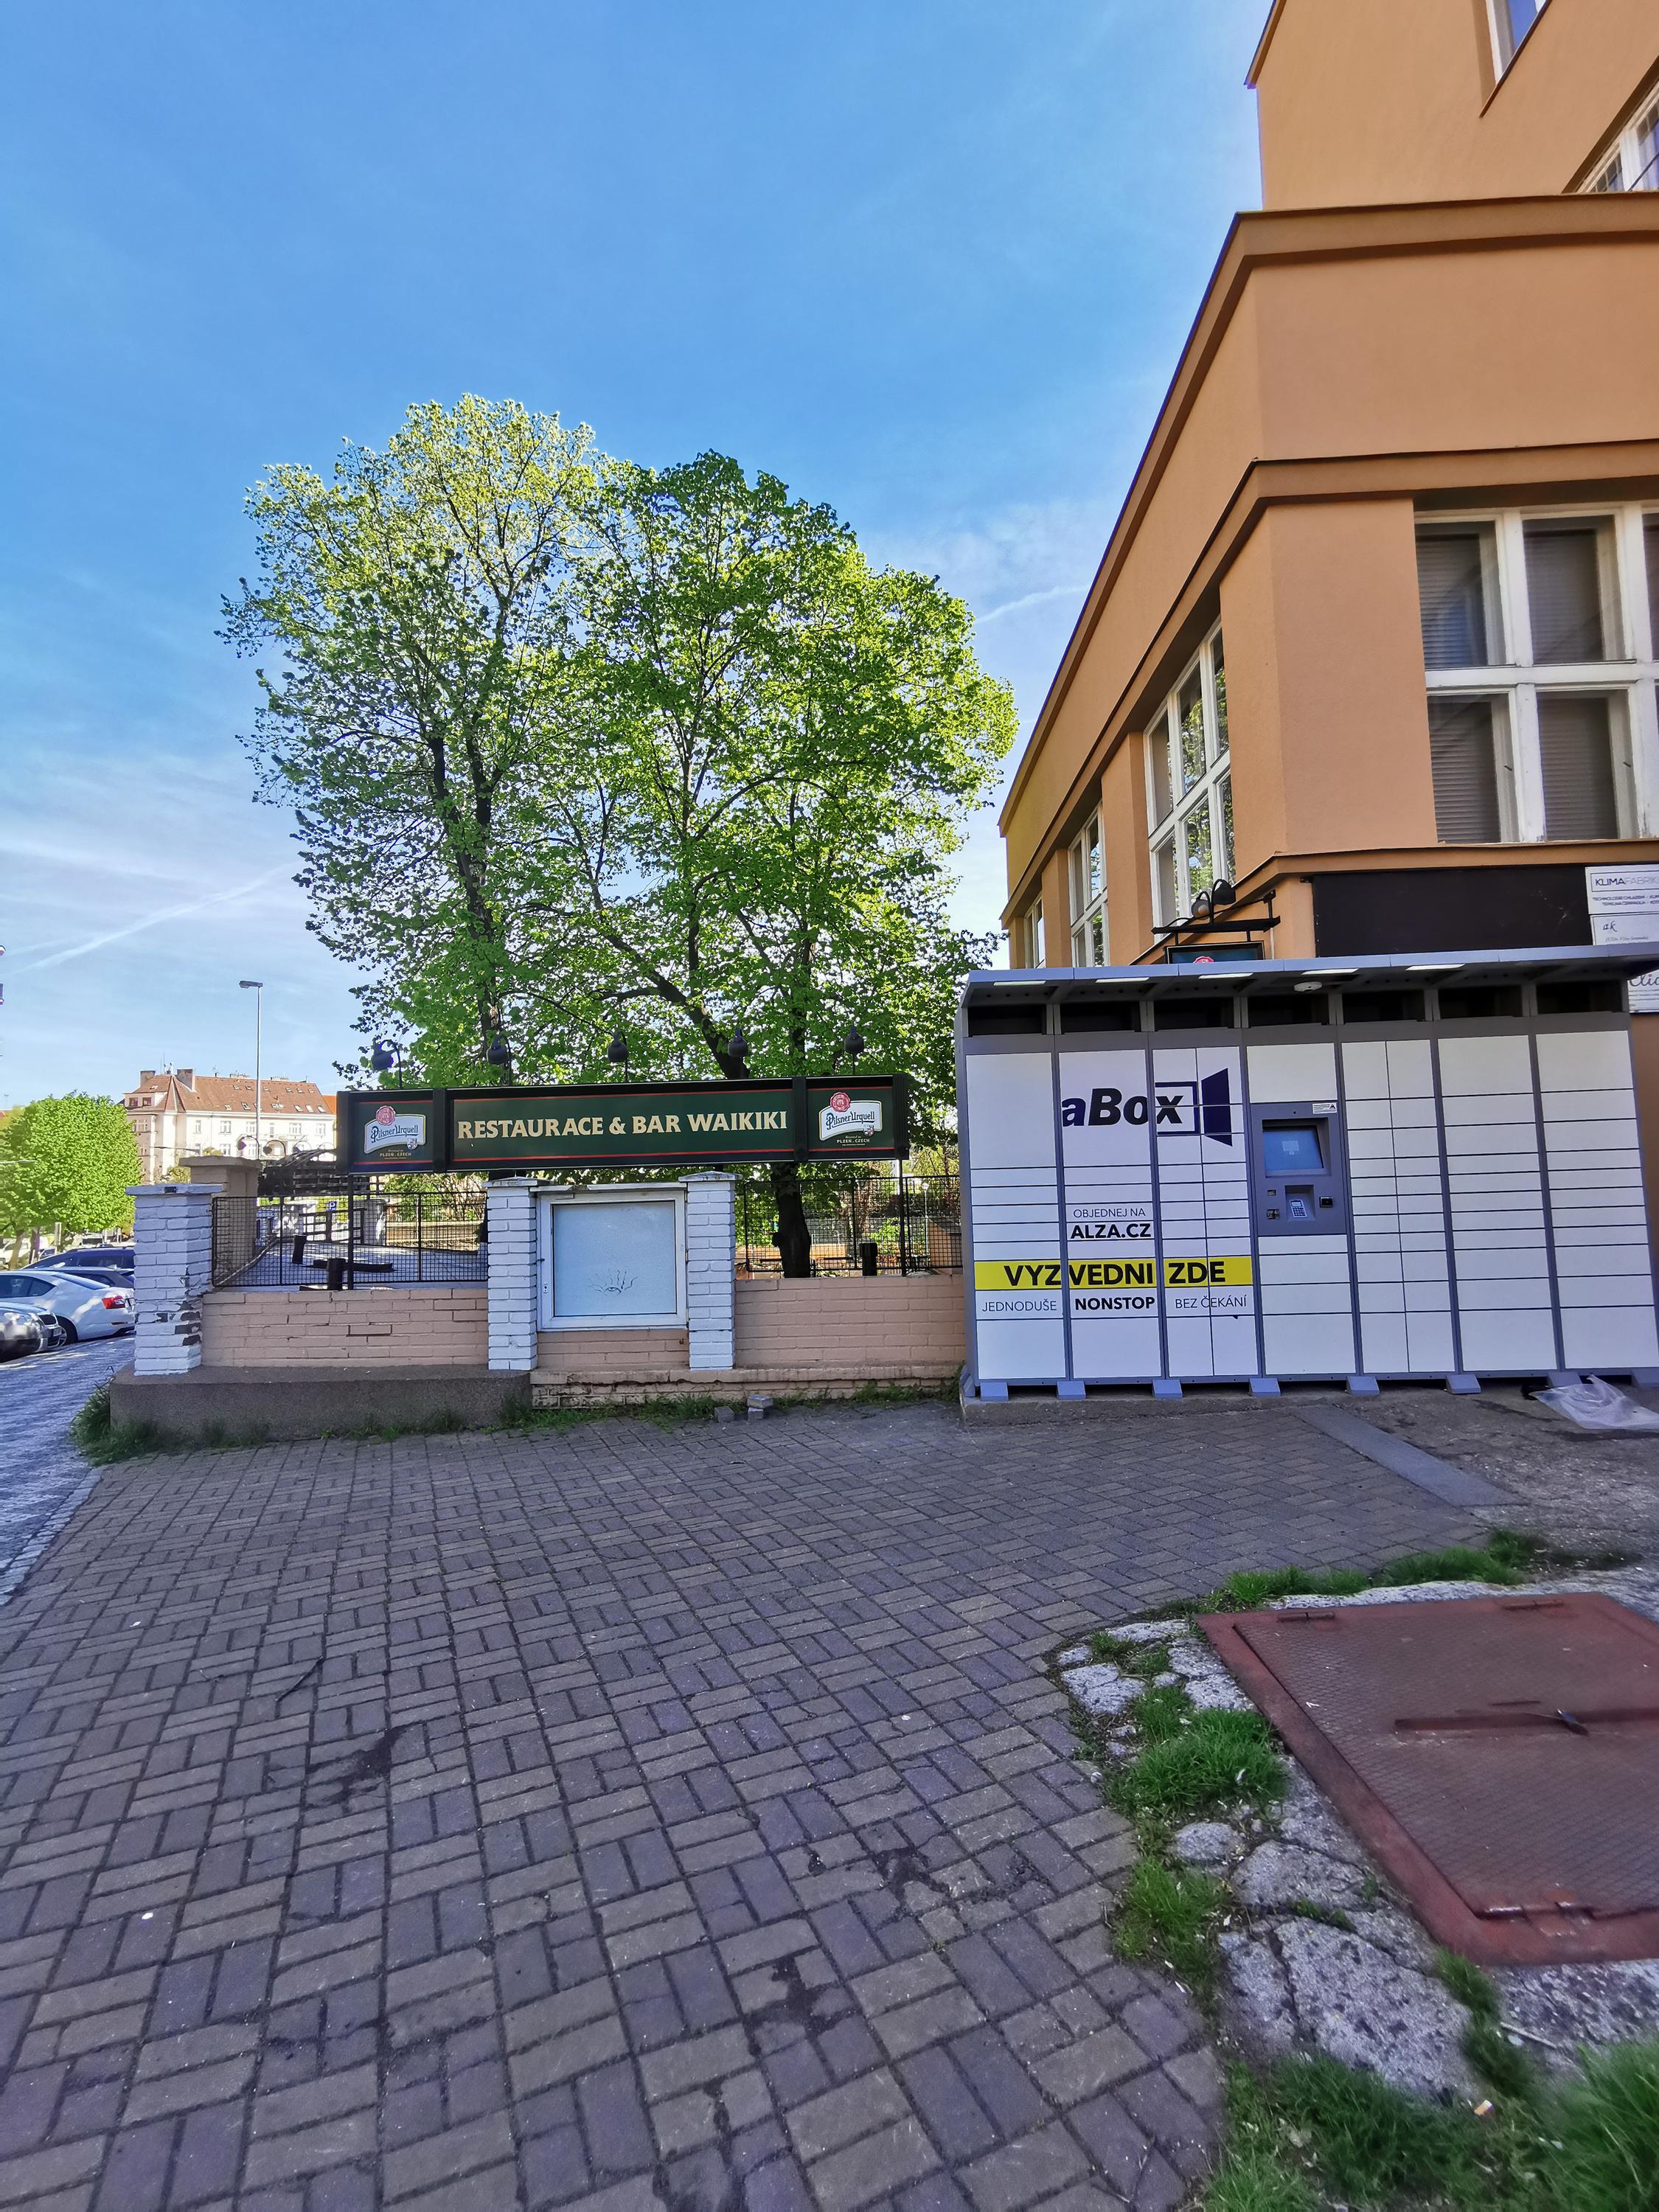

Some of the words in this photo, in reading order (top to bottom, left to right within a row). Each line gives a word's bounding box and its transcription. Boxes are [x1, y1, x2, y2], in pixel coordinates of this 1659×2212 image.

[1596, 877, 1659, 886] KLIMAFABRIK
[1062, 1088, 1183, 1127] aBox
[457, 1117, 604, 1139] RESTAURACE
[608, 1116, 626, 1135] &
[632, 1115, 681, 1134] BAR
[686, 1110, 787, 1132] WAIKIKI
[826, 1112, 851, 1130] Pilsner
[850, 1111, 875, 1124] Urquell
[371, 1126, 395, 1143] Pilsner
[394, 1124, 418, 1137] Urquell
[1073, 1208, 1127, 1218] OBJEDNEJ
[1130, 1208, 1146, 1217] NA
[1071, 1223, 1152, 1239] ALZA.CZ
[1004, 1262, 1153, 1286] VYZVEDNI
[1168, 1261, 1225, 1284] ZDE
[982, 1298, 1057, 1312] JEDNODUŠE
[1075, 1296, 1155, 1310] NONSTOP
[1175, 1298, 1197, 1309] BEZ
[1200, 1294, 1247, 1308] ČEKÁNÍ
